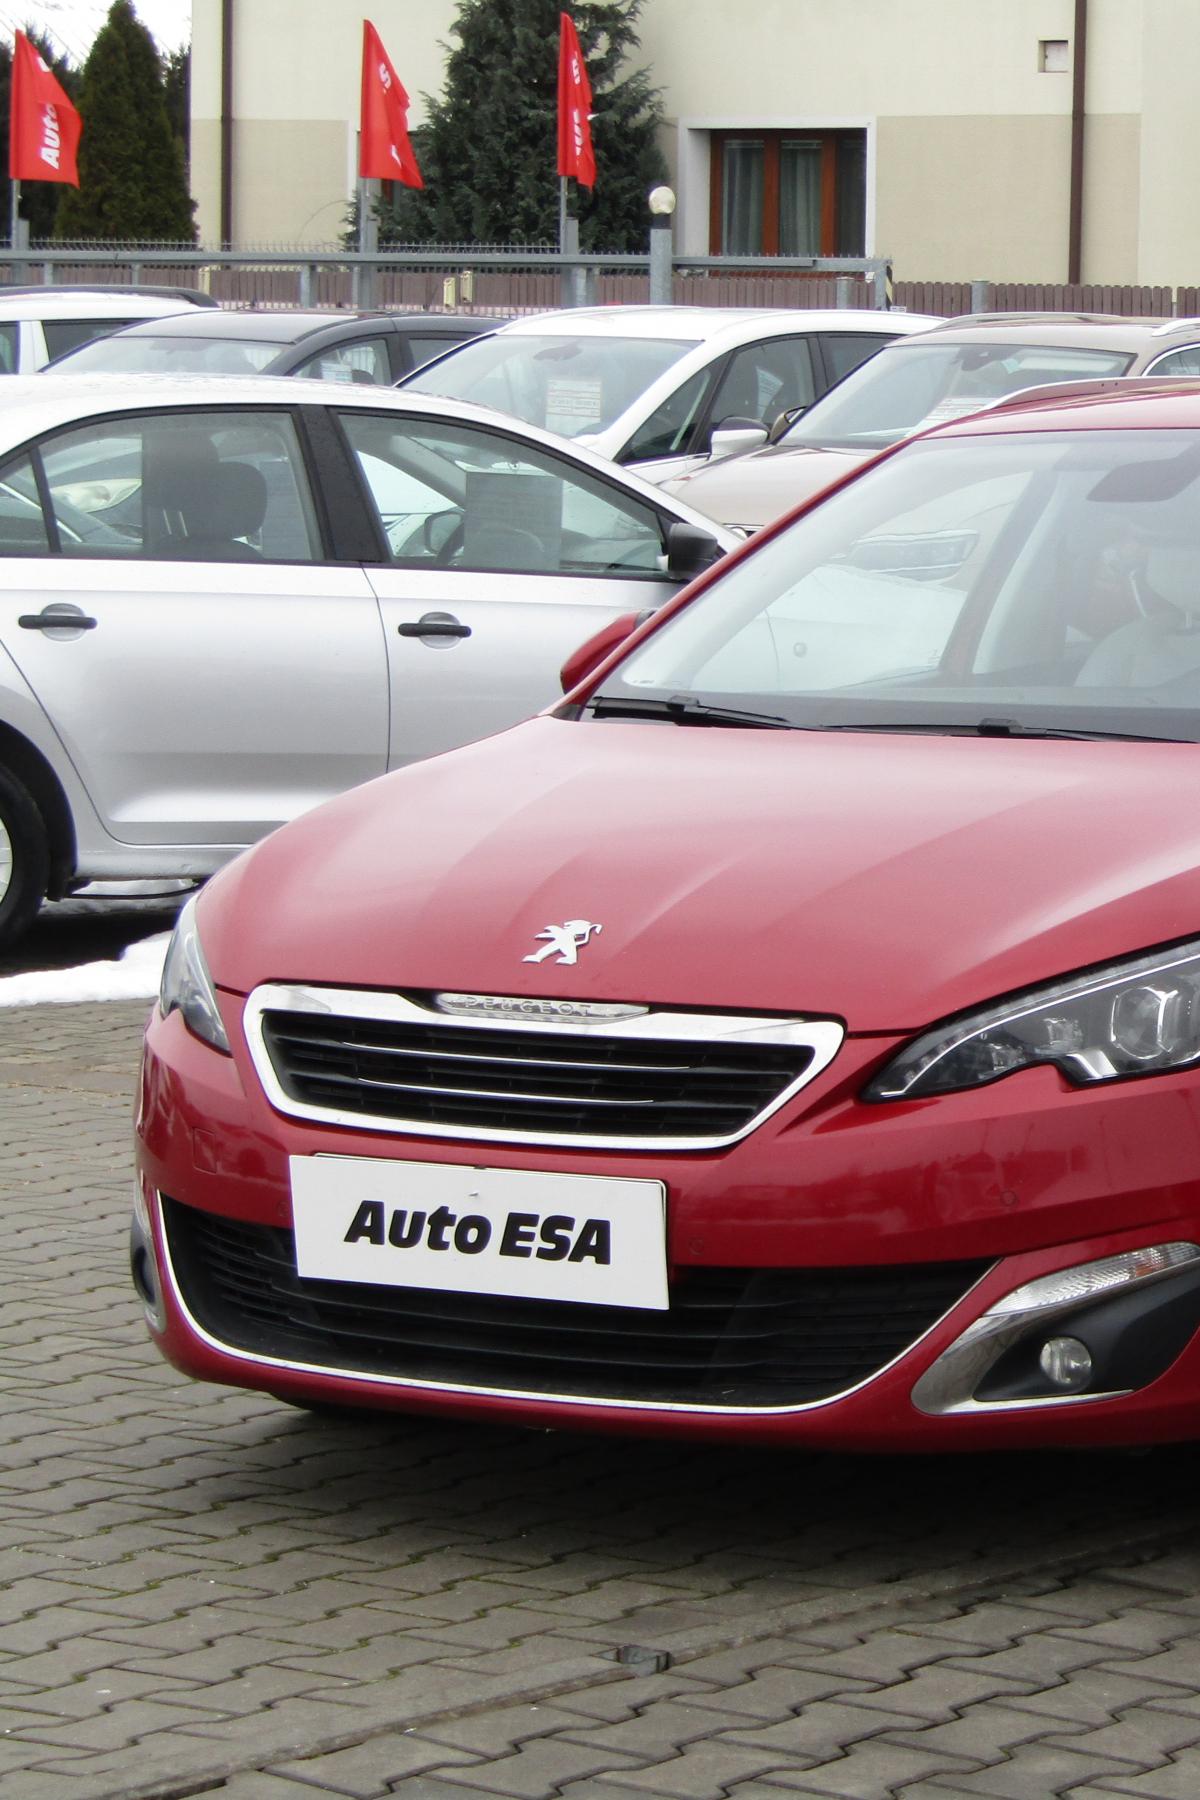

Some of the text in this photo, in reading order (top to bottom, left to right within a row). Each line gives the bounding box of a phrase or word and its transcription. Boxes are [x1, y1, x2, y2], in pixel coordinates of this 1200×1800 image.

[464, 996, 592, 1016] PEUGEOT
[343, 1199, 611, 1265] Auto ESA
